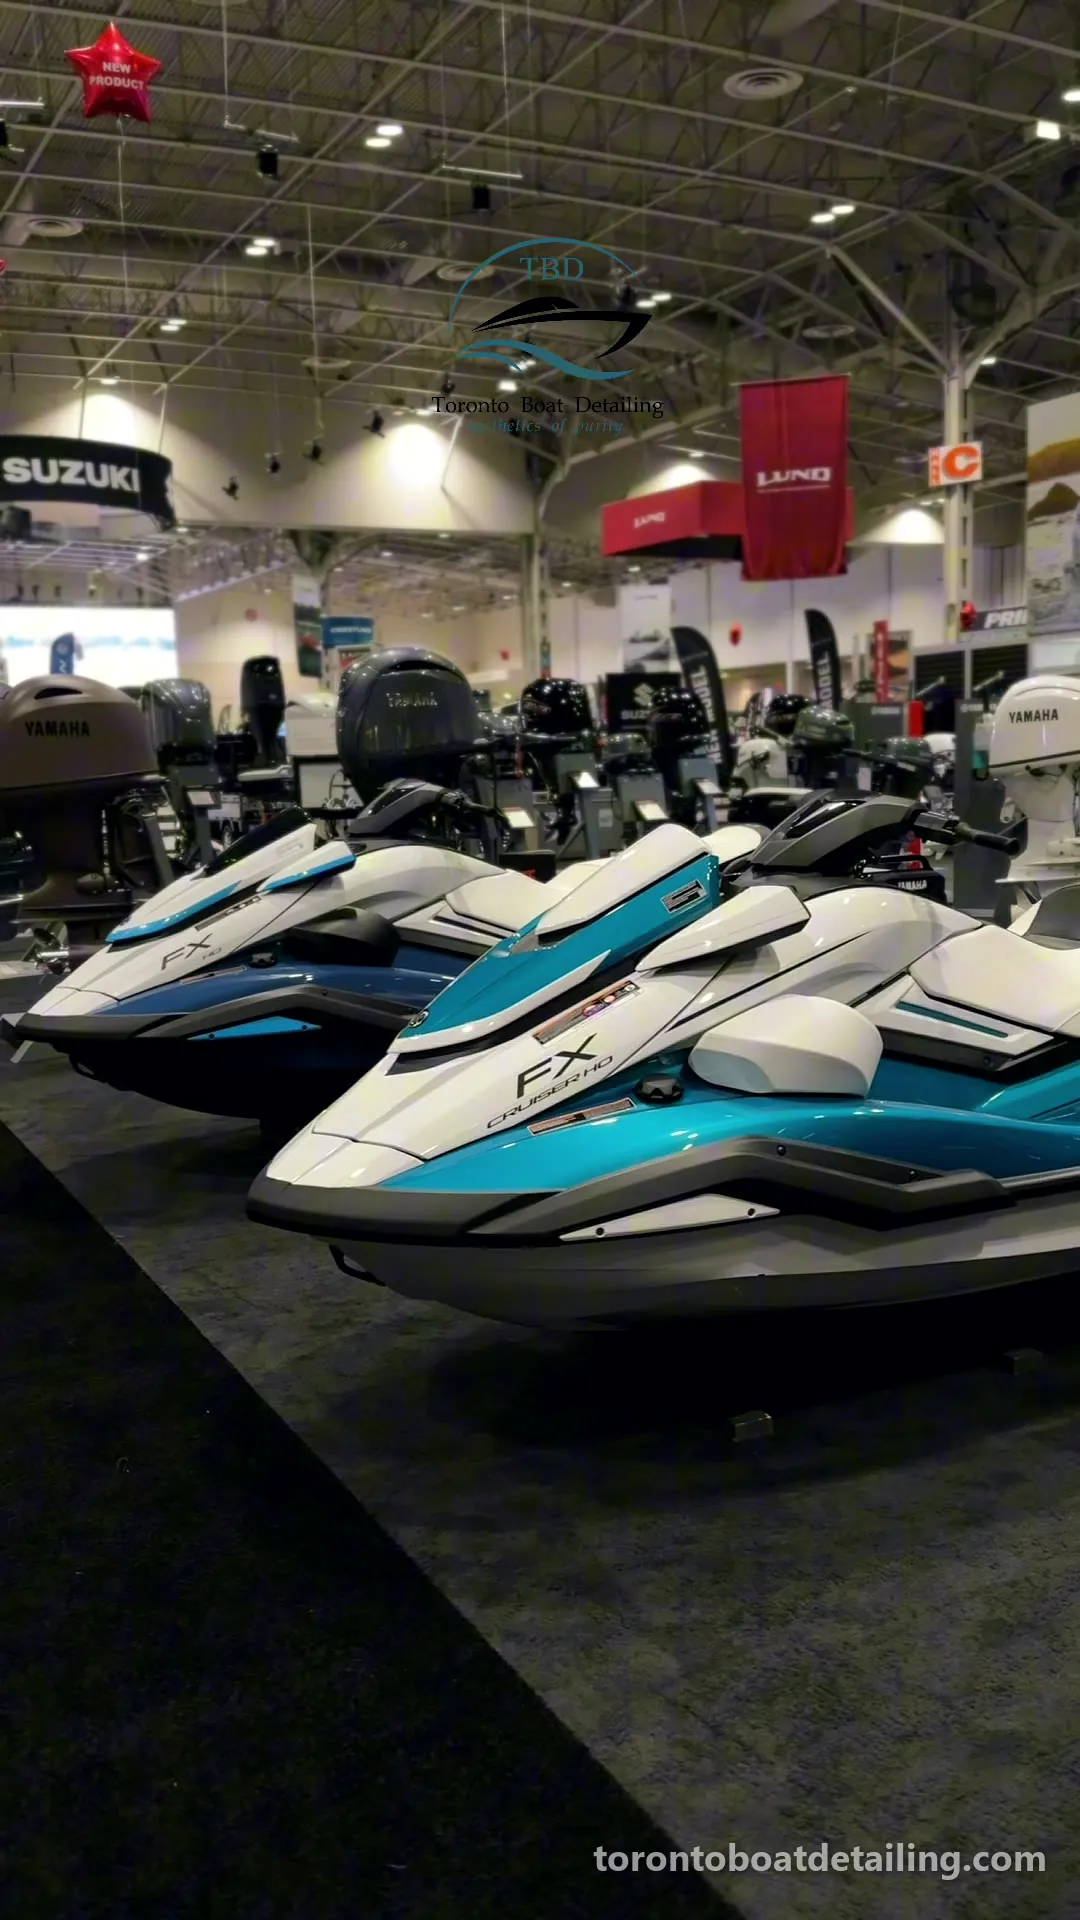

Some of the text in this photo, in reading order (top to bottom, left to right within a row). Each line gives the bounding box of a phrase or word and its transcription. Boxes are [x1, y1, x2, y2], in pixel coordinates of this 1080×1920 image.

[102, 61, 131, 73] NEW
[89, 75, 144, 90] PRODUCT
[2, 456, 140, 493] SUZUKI
[943, 445, 979, 479] C
[757, 467, 831, 487] LUND
[25, 721, 90, 737] YAMAHA
[1008, 708, 1059, 723] YAMAHA
[161, 933, 212, 970] FX
[517, 1033, 598, 1099] FX
[487, 1073, 580, 1129] CRUISER
[583, 1055, 613, 1077] HO
